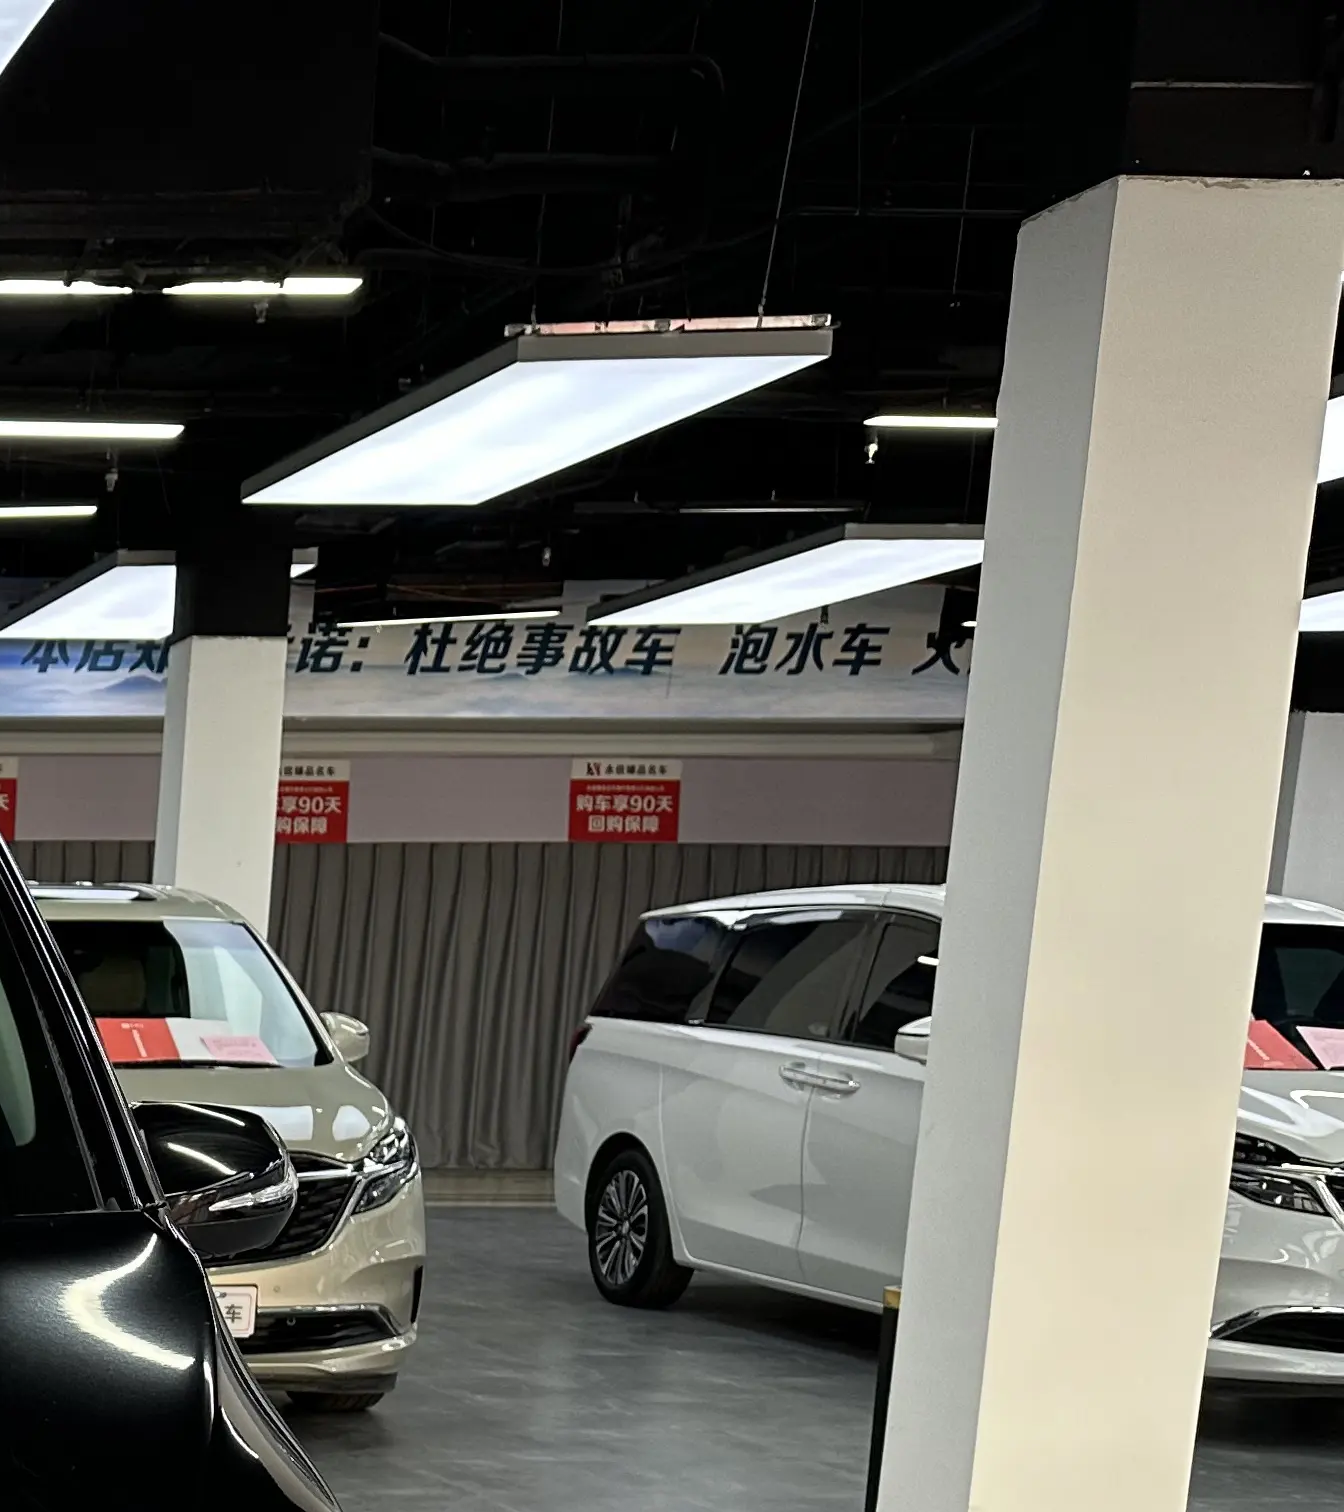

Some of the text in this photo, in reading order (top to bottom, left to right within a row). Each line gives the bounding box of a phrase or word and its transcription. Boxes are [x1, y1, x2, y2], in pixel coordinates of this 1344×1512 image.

[405, 622, 682, 676] 杜绝事故车
[718, 624, 891, 676] 泡水车
[279, 765, 337, 777] 信臻品名车
[276, 795, 342, 815] 享90天
[575, 793, 674, 813] 购车享90天
[587, 814, 660, 834] 回购保障
[224, 1303, 244, 1324] 车
